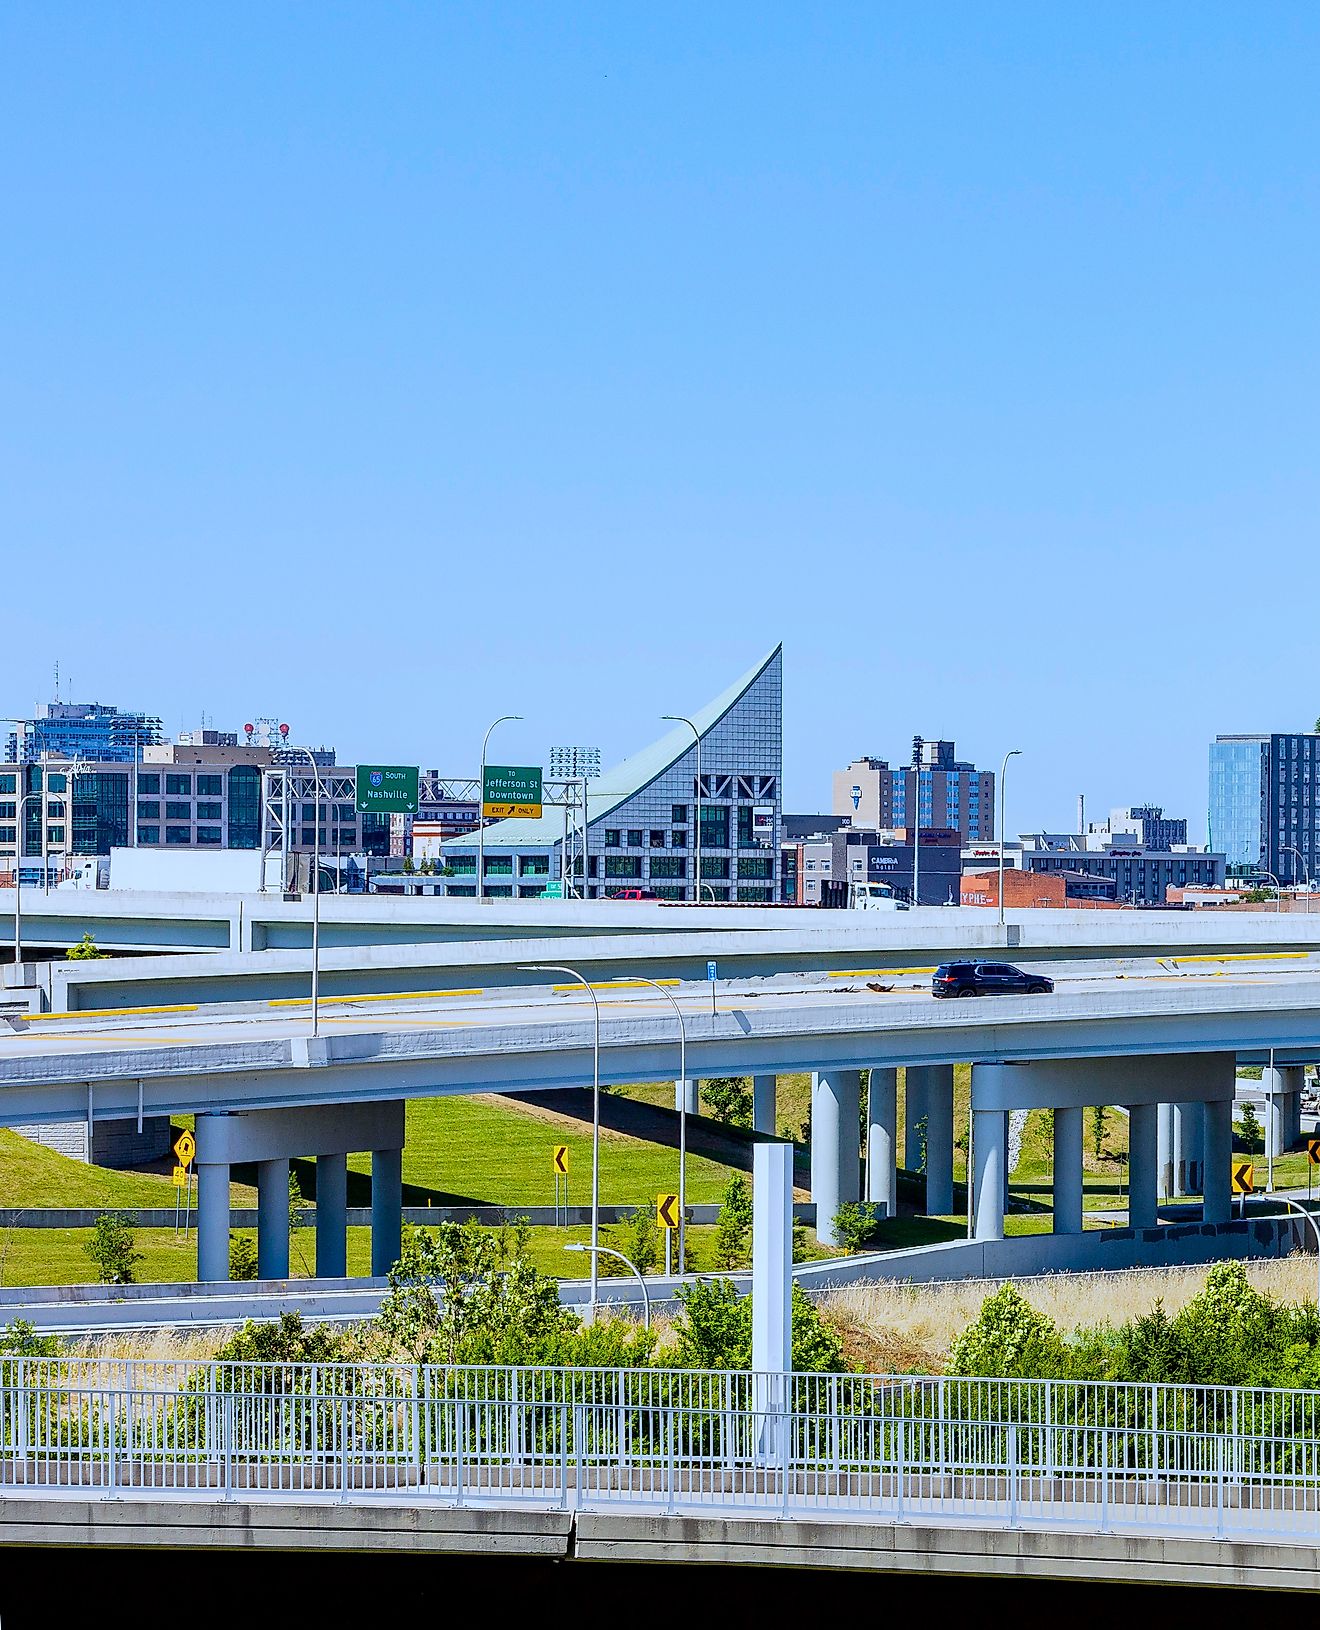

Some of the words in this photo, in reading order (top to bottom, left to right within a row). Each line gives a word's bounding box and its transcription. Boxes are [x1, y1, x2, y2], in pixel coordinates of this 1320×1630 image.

[372, 775, 381, 783] 65
[385, 771, 406, 780] SOUTH
[485, 779, 526, 788] Jefferson
[529, 780, 538, 788] St
[367, 790, 408, 799] Nashville
[489, 791, 534, 800] Downtown
